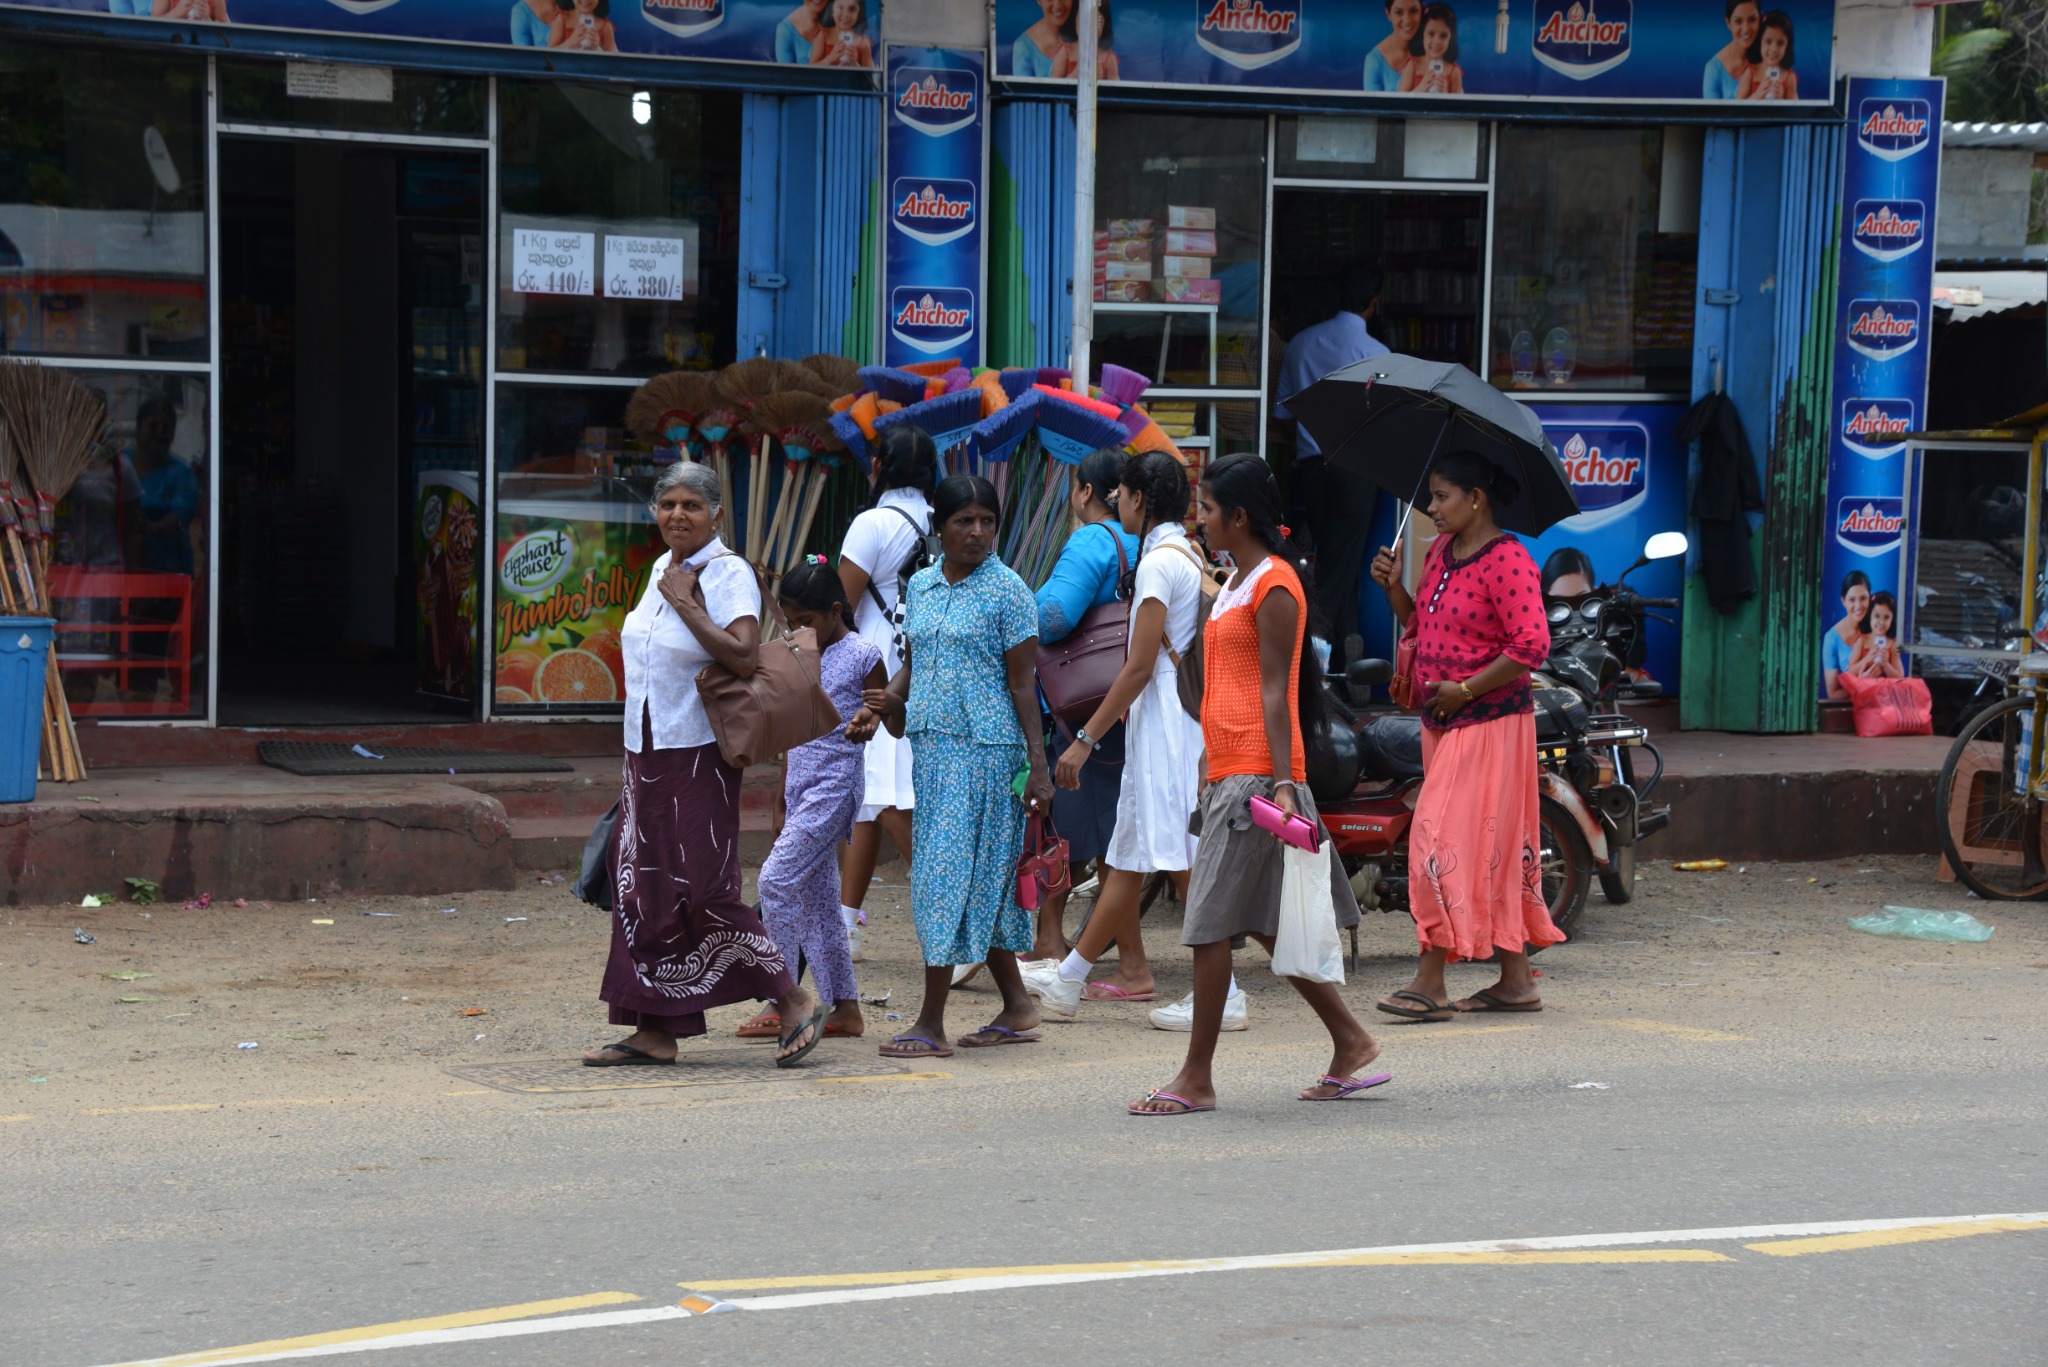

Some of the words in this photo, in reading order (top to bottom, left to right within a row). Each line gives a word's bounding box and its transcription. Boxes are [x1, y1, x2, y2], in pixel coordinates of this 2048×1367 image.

[647, 0, 717, 10] ncor
[1203, 0, 1295, 32] Anchor
[1539, 11, 1626, 44] Anchor
[900, 83, 971, 108] Anchor
[1863, 112, 1925, 135] Anchor
[898, 193, 969, 217] Anchor
[1857, 213, 1919, 236] Anchor
[531, 234, 546, 250] Kg
[613, 240, 622, 255] Kg
[897, 301, 968, 326] Anchor
[1852, 313, 1914, 337] Anchor
[1846, 413, 1909, 434] Anchor
[1557, 448, 1640, 485] nchor
[1842, 511, 1902, 532] Anchor
[503, 531, 566, 578] Elephant
[513, 557, 553, 586] House
